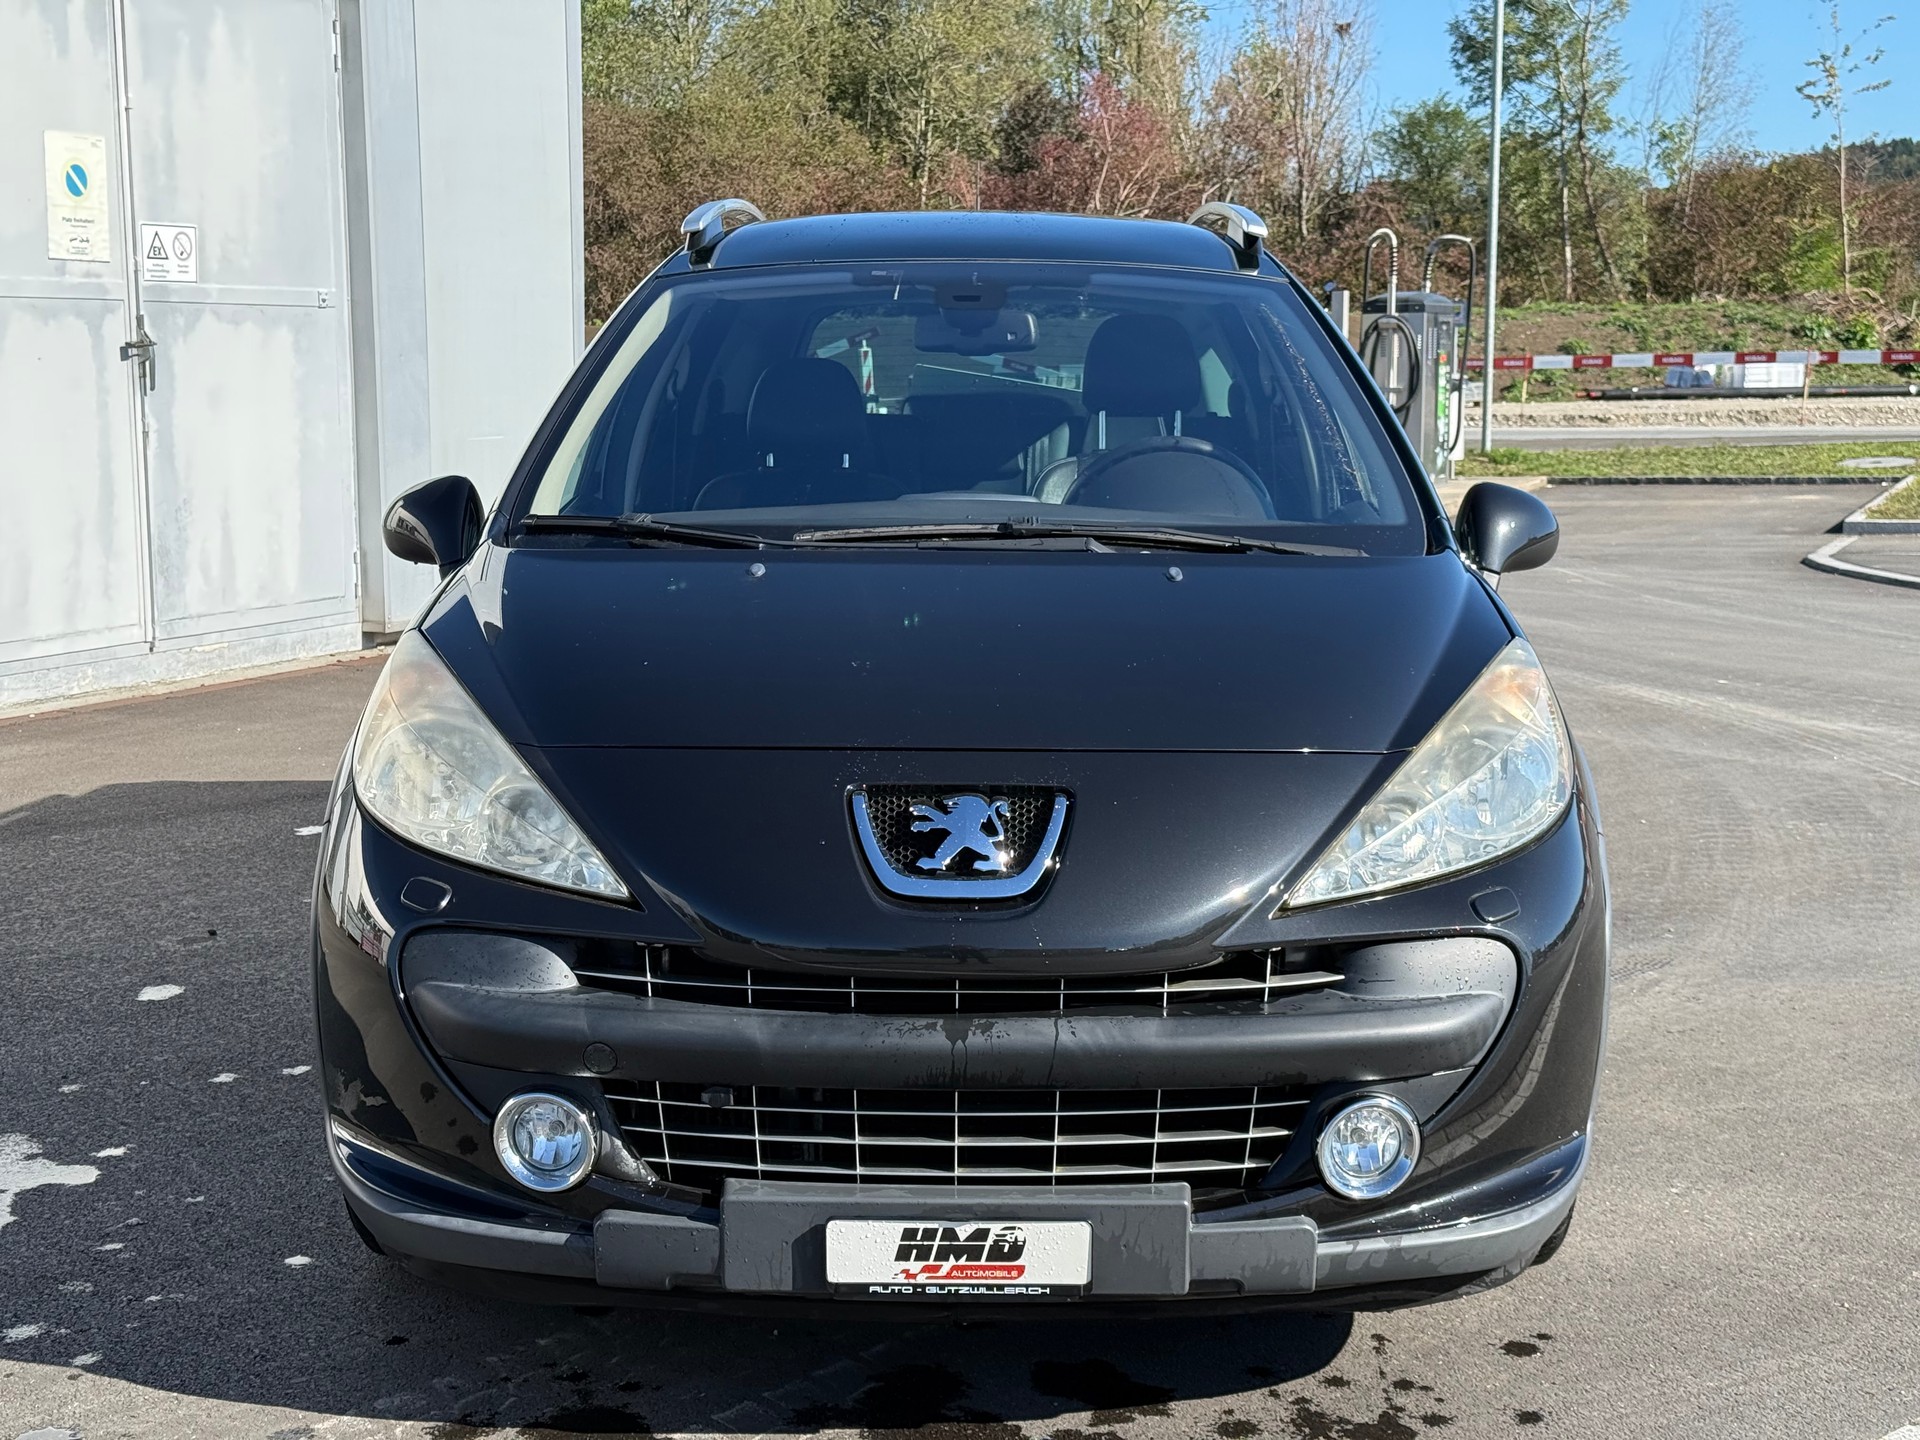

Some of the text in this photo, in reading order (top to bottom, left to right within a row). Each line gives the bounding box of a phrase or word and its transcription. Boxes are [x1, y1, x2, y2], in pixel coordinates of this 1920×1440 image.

[153, 246, 163, 256] EX
[951, 1270, 1019, 1278] AUTOMOBILE
[869, 1286, 913, 1294] AUTO
